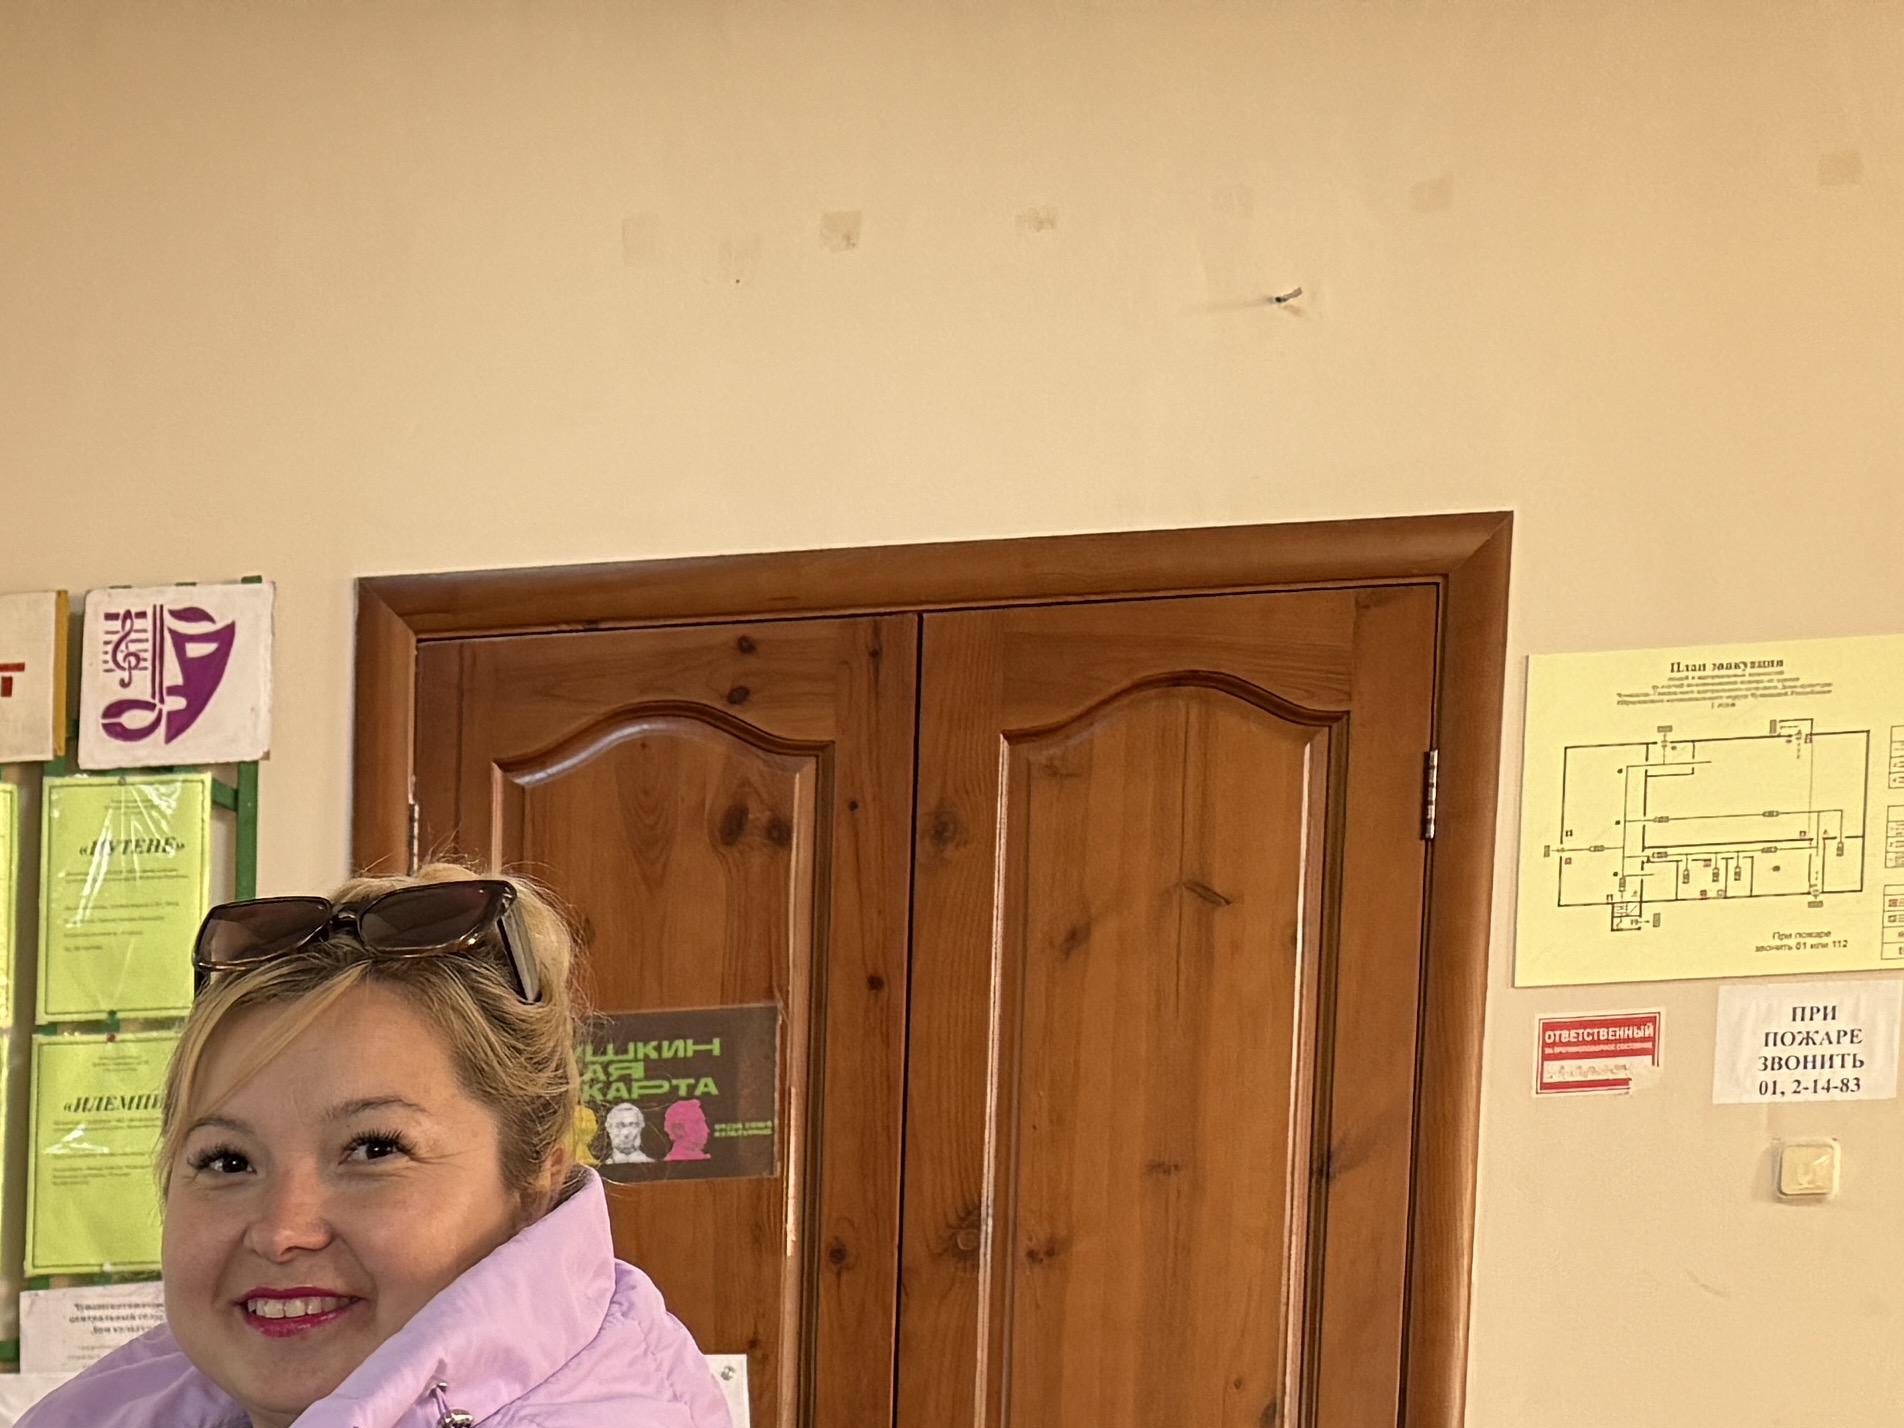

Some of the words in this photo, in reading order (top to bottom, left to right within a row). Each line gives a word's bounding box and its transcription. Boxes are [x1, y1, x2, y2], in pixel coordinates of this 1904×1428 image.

[1670, 661, 1707, 673] План
[1832, 939, 1848, 948] 112
[1791, 1005, 1838, 1023] ПРИ
[1545, 1022, 1654, 1044] ОТВЕТСТВЕННЫЙ
[1764, 1028, 1864, 1049] ПОЖАРЕ
[1758, 1052, 1865, 1072] ЗВОНИТЬ
[582, 1077, 719, 1102] КАРТА
[1759, 1078, 1787, 1099] 01,
[1791, 1076, 1862, 1096] 2-14-83
